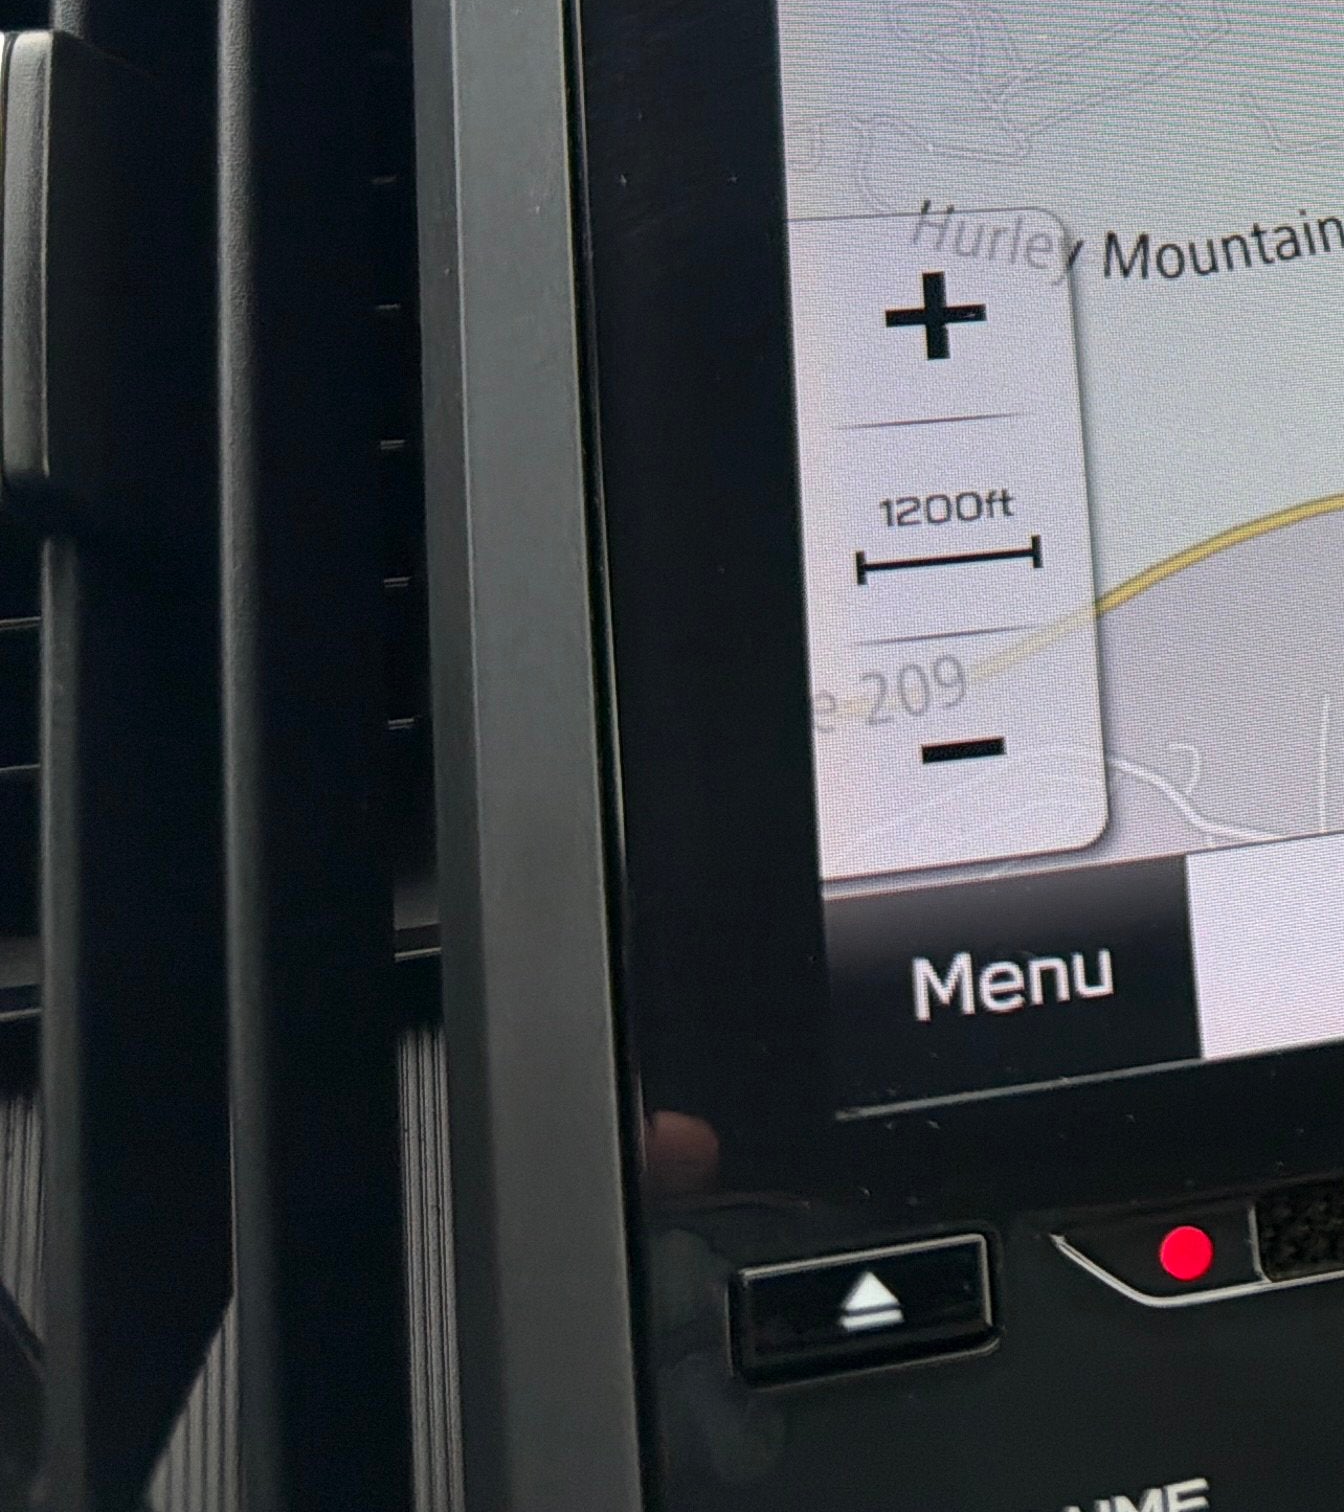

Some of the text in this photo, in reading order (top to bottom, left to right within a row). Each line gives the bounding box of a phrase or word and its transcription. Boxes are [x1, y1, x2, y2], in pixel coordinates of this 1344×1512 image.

[912, 199, 1083, 285] Hurley
[877, 486, 1018, 530] 1200ft
[859, 653, 968, 727] 209
[909, 946, 1117, 1024] Menu
